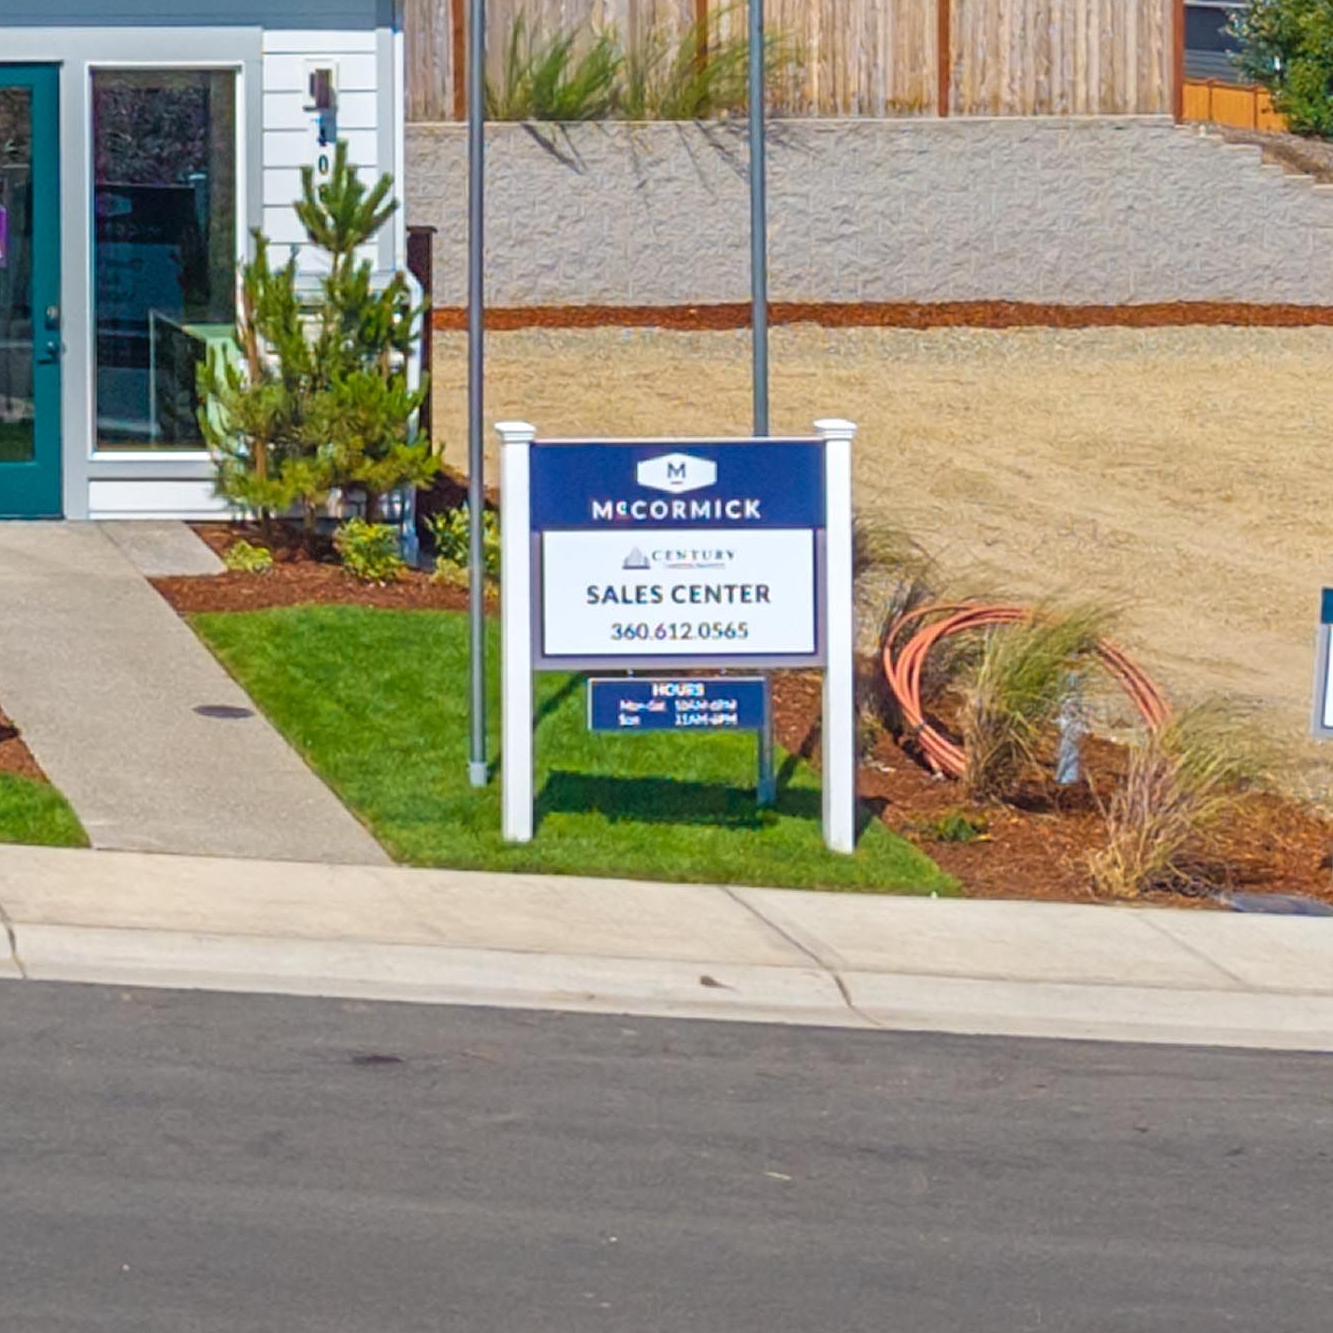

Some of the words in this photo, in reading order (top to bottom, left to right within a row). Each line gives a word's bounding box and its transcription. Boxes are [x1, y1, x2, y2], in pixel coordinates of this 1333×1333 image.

[667, 463, 686, 478] M
[651, 550, 735, 561] CENTURY
[587, 585, 663, 604] SALES
[671, 585, 771, 604] CENTER
[611, 623, 748, 640] 360.612.0565
